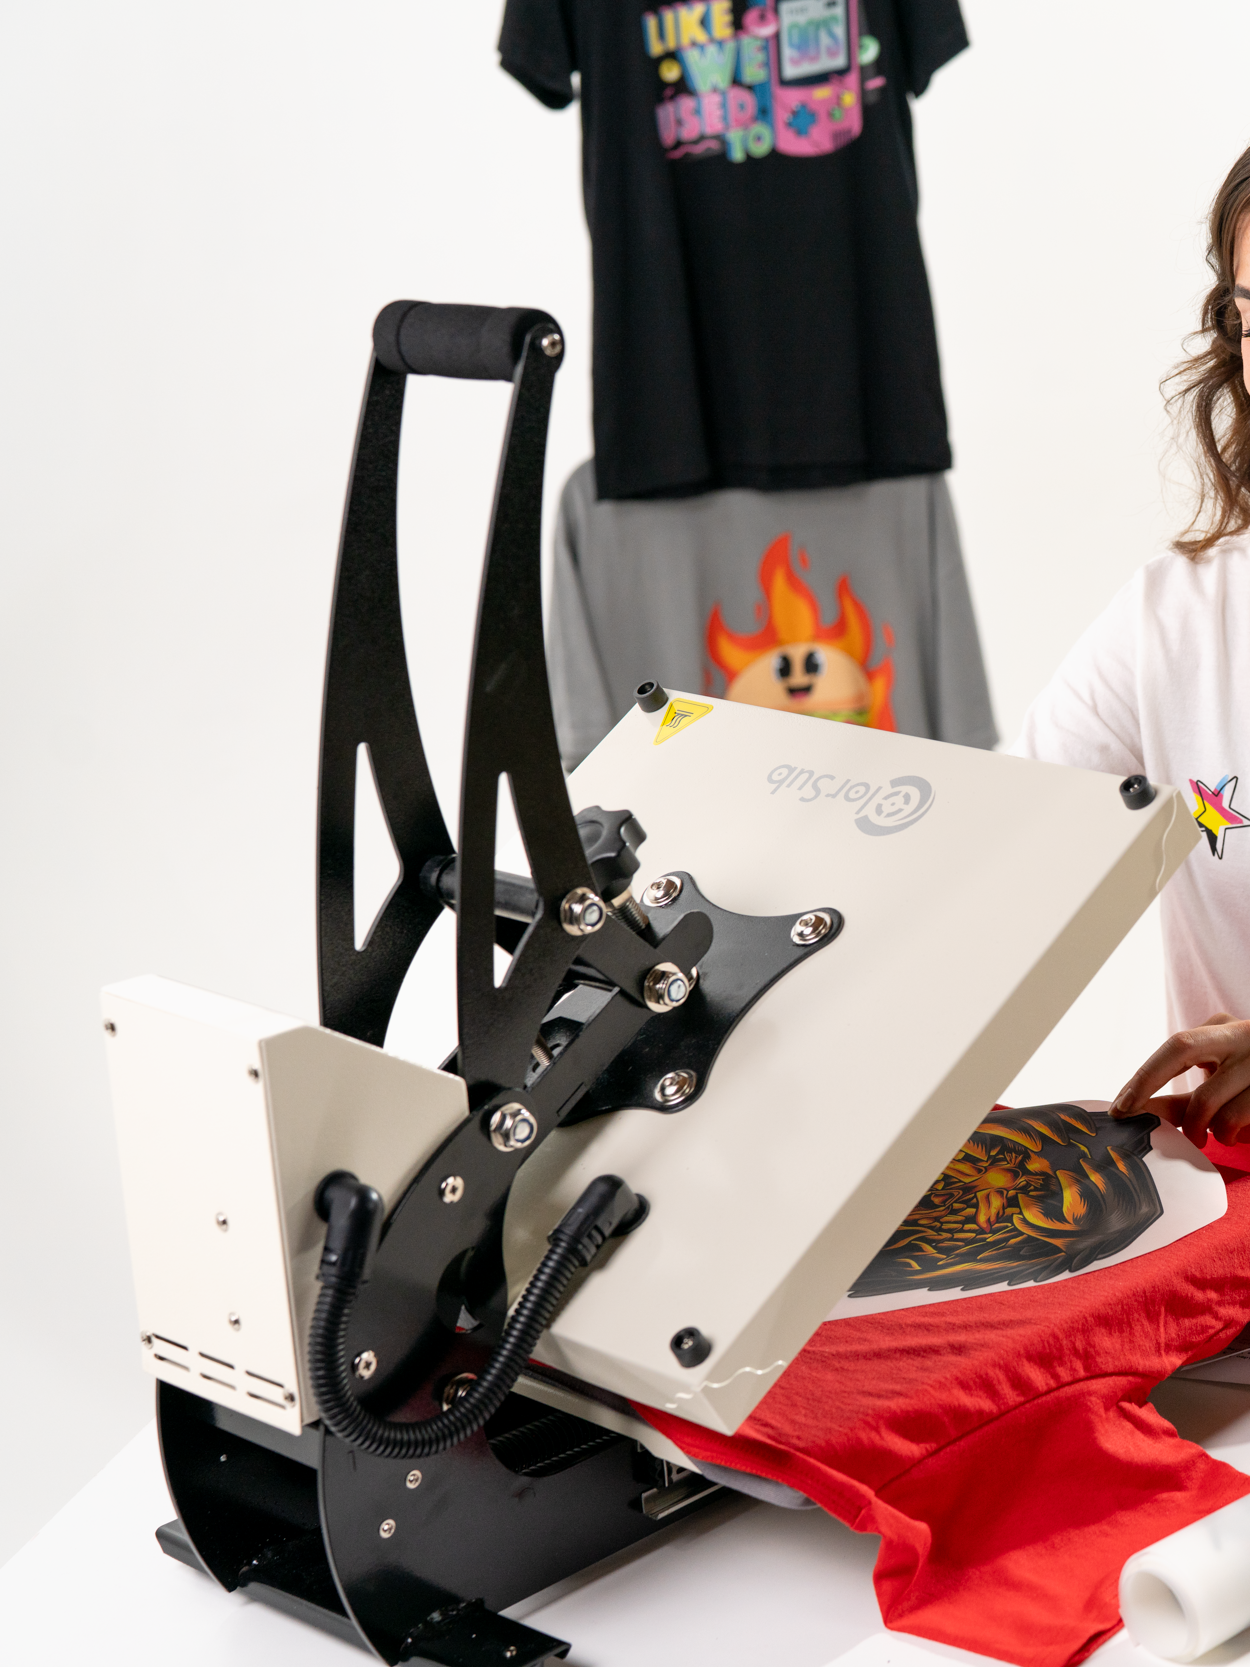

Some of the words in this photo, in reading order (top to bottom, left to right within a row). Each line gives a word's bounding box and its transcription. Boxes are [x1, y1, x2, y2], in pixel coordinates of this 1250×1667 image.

[641, 0, 734, 58] LIKE
[676, 37, 770, 92] WE
[725, 122, 774, 163] TO
